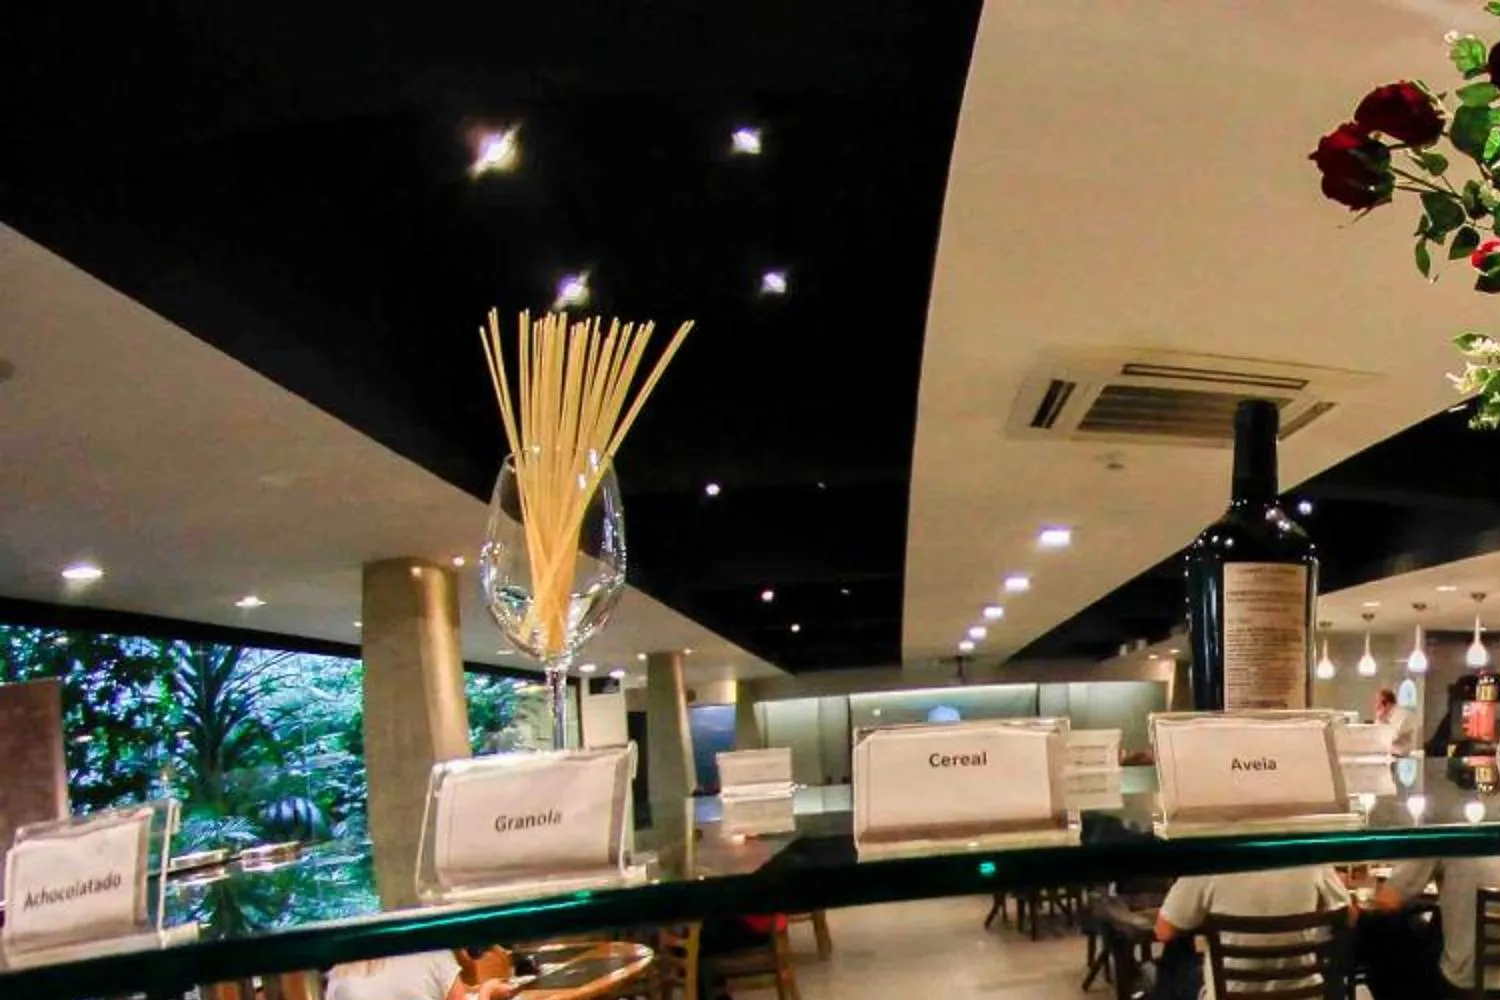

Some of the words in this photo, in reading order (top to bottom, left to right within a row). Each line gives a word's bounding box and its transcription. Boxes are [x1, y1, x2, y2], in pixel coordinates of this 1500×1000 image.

[928, 751, 988, 768] Cereal
[1231, 757, 1277, 771] Aveia
[495, 808, 562, 833] Granola
[23, 869, 122, 911] Achocolatado
